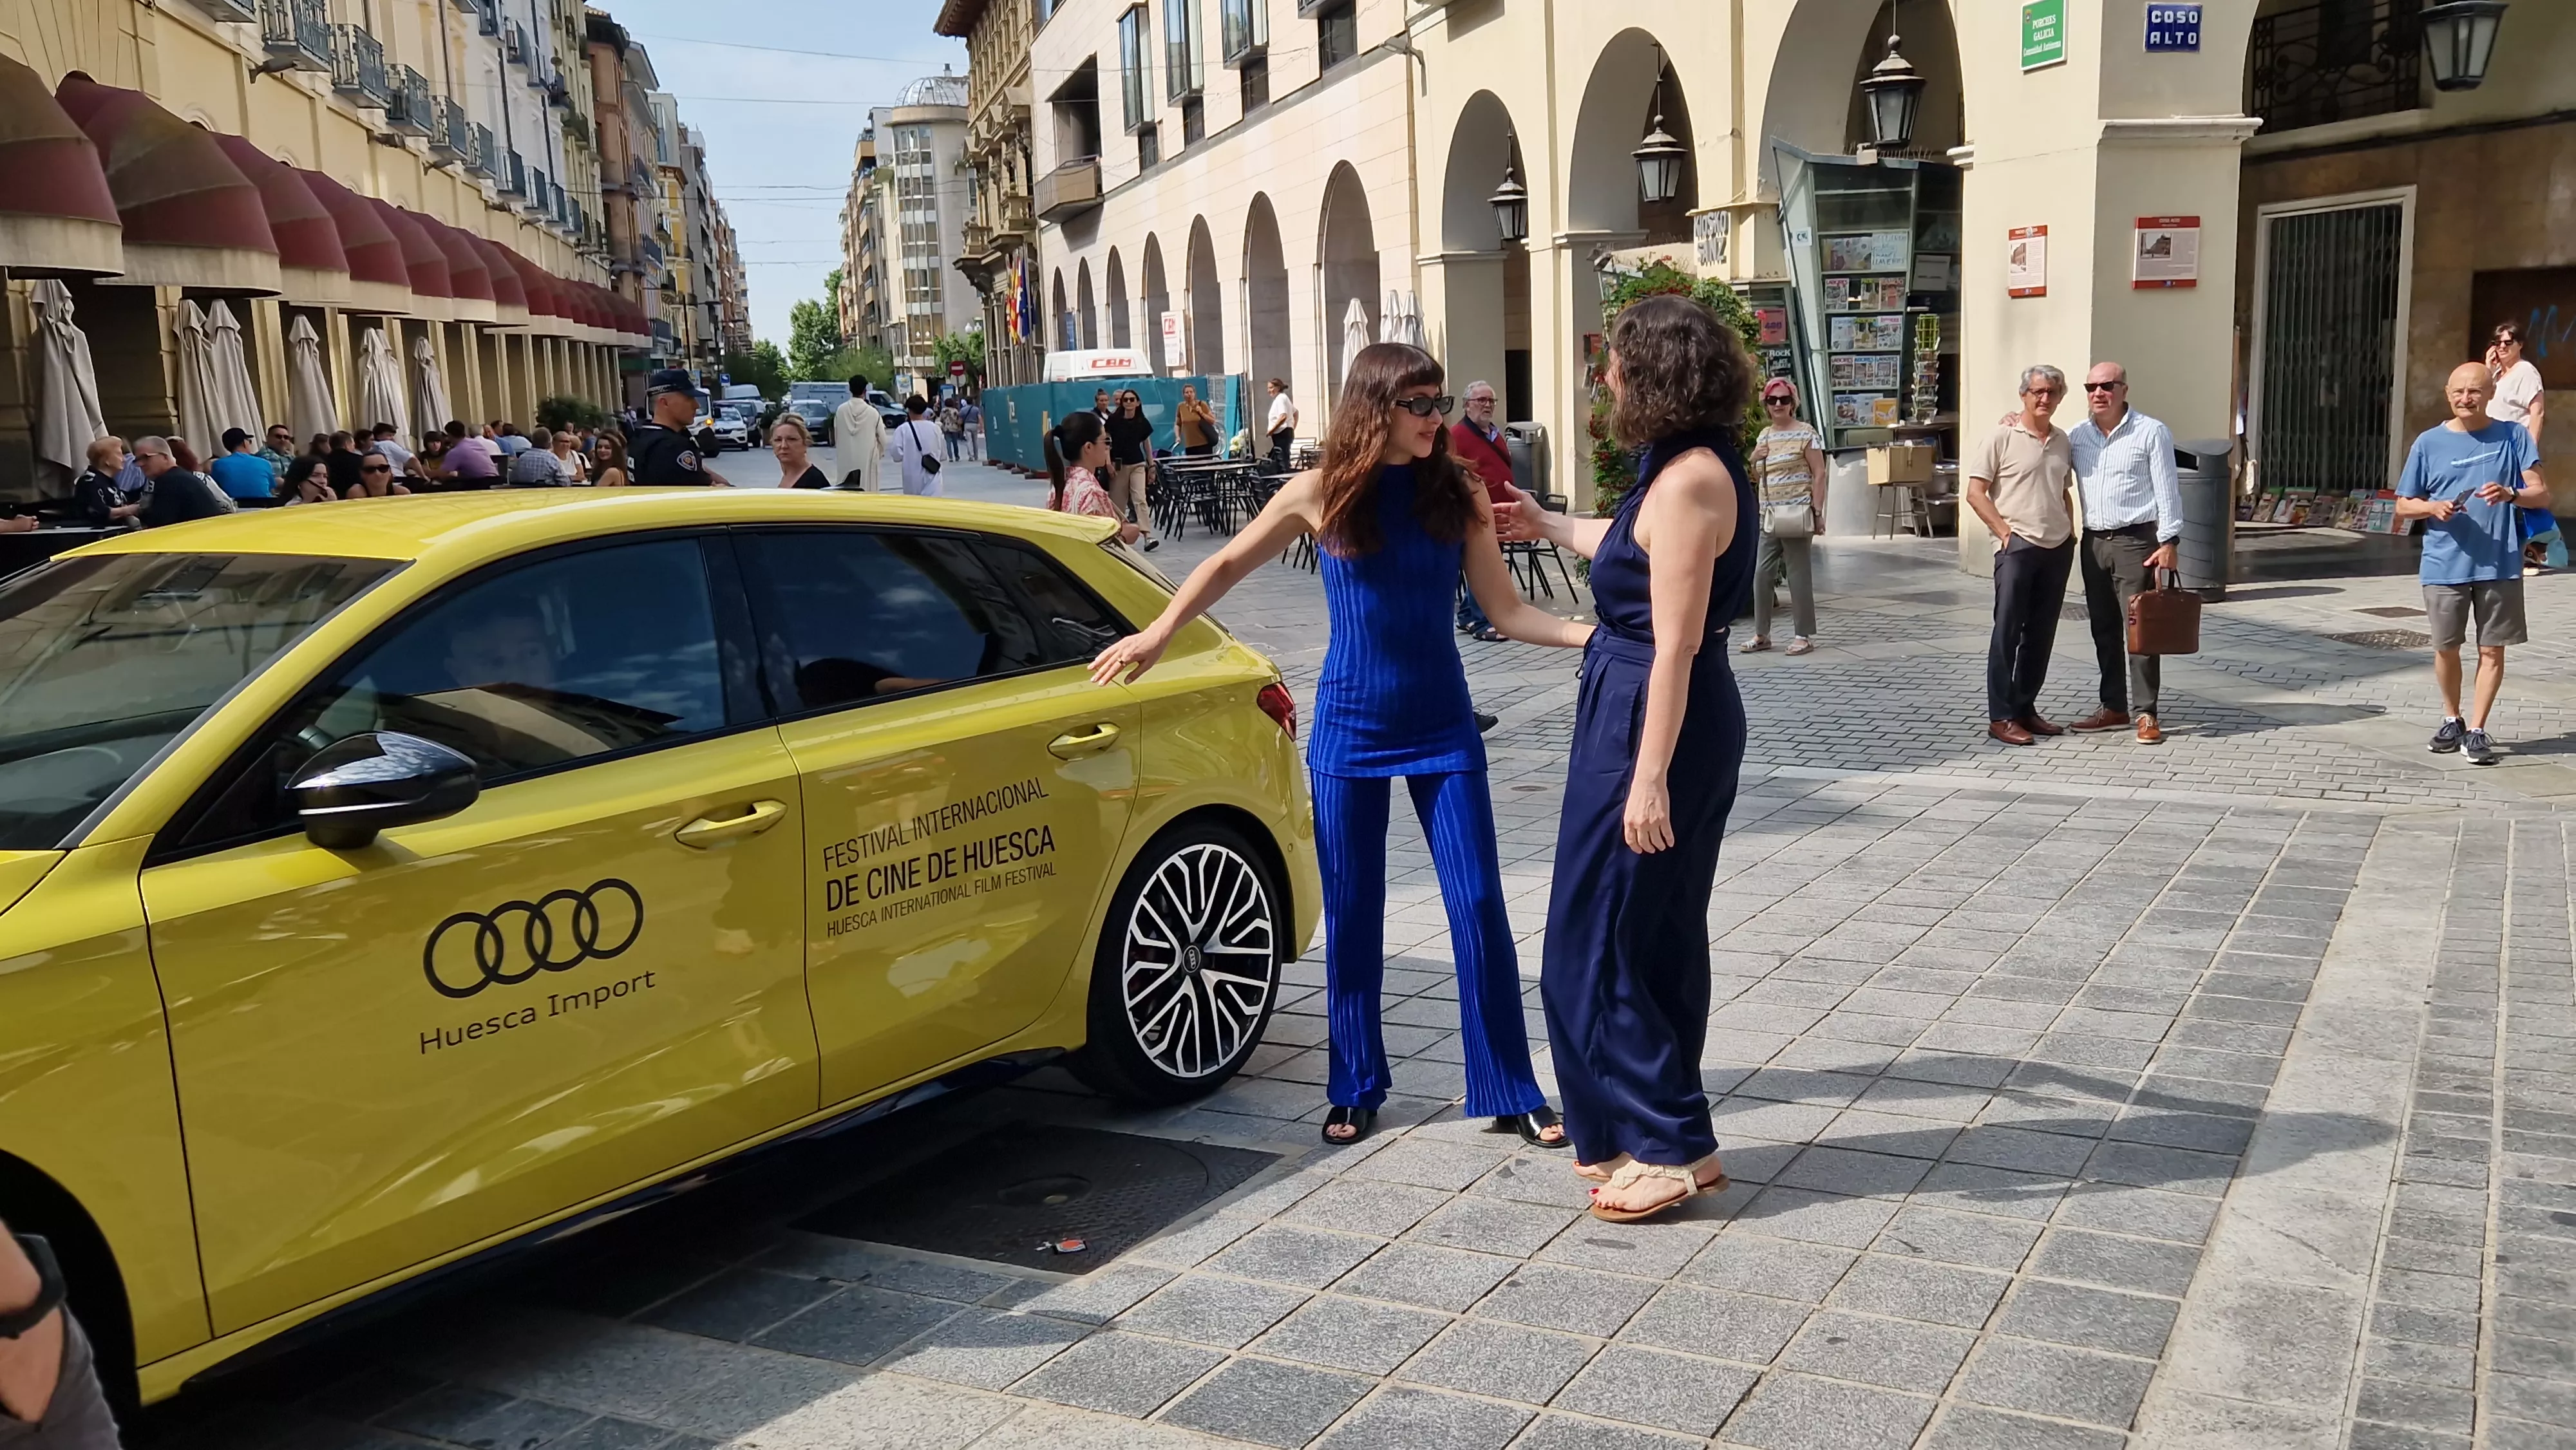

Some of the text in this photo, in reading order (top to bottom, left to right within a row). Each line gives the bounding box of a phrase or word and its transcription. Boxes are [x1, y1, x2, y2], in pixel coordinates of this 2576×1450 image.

[2032, 14, 2056, 30] PORCHES
[2151, 10, 2198, 24] COSO
[2033, 28, 2055, 41] GALICIA
[2150, 31, 2197, 44] ALTO
[1694, 210, 1728, 237] KIOSKO
[1697, 237, 1725, 264] SANZ
[1091, 358, 1132, 369] CAM
[822, 777, 1050, 872] FESTIVAL INTERNACIONAL
[826, 824, 1056, 912] DE CINE DE HUESCA
[826, 861, 1057, 938] HUESCA INTERNATIONAL FILM FESTIVAL
[419, 970, 656, 1055] Huesca Import
